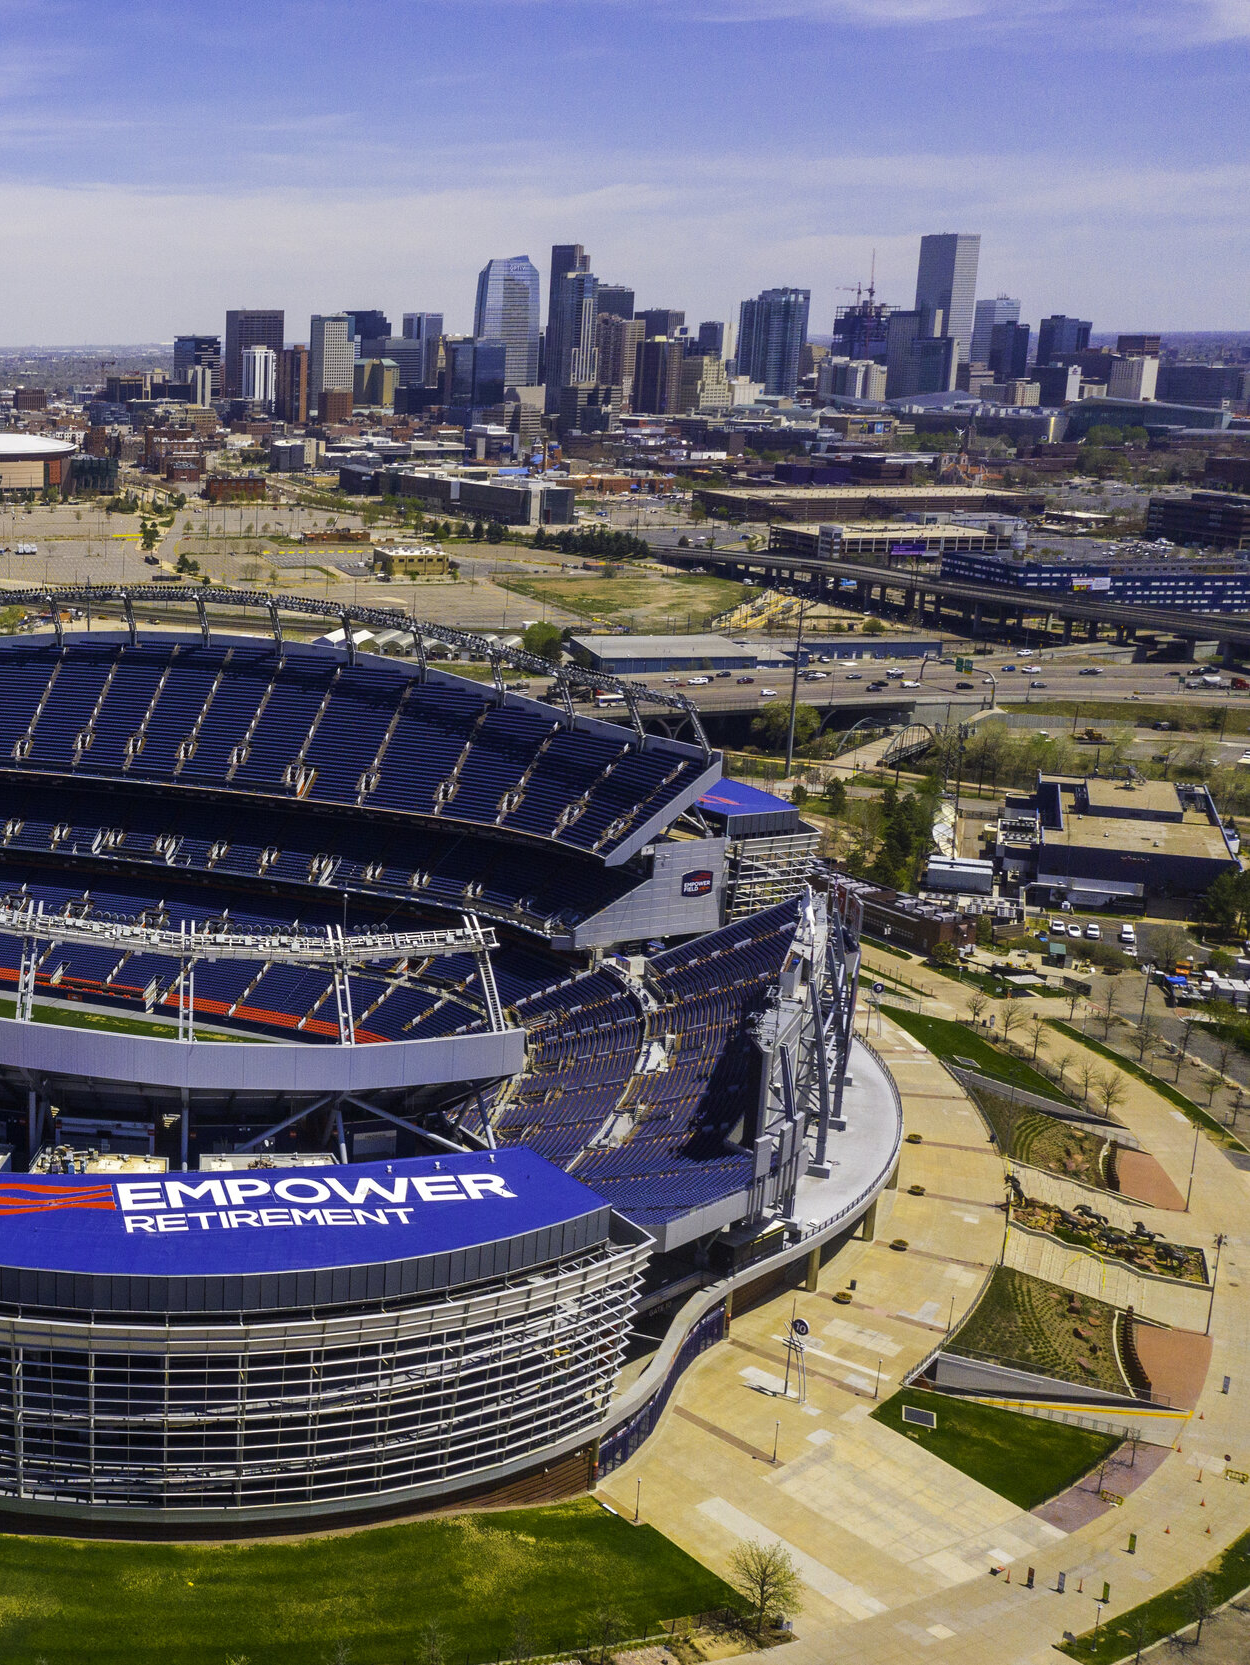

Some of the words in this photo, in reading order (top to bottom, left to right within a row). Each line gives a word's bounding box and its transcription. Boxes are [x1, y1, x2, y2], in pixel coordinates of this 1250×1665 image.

[683, 880, 710, 888] EMPOWER
[116, 1173, 518, 1211] EMPOWER
[124, 1207, 414, 1233] RETIREMENT
[795, 1321, 807, 1333] 10
